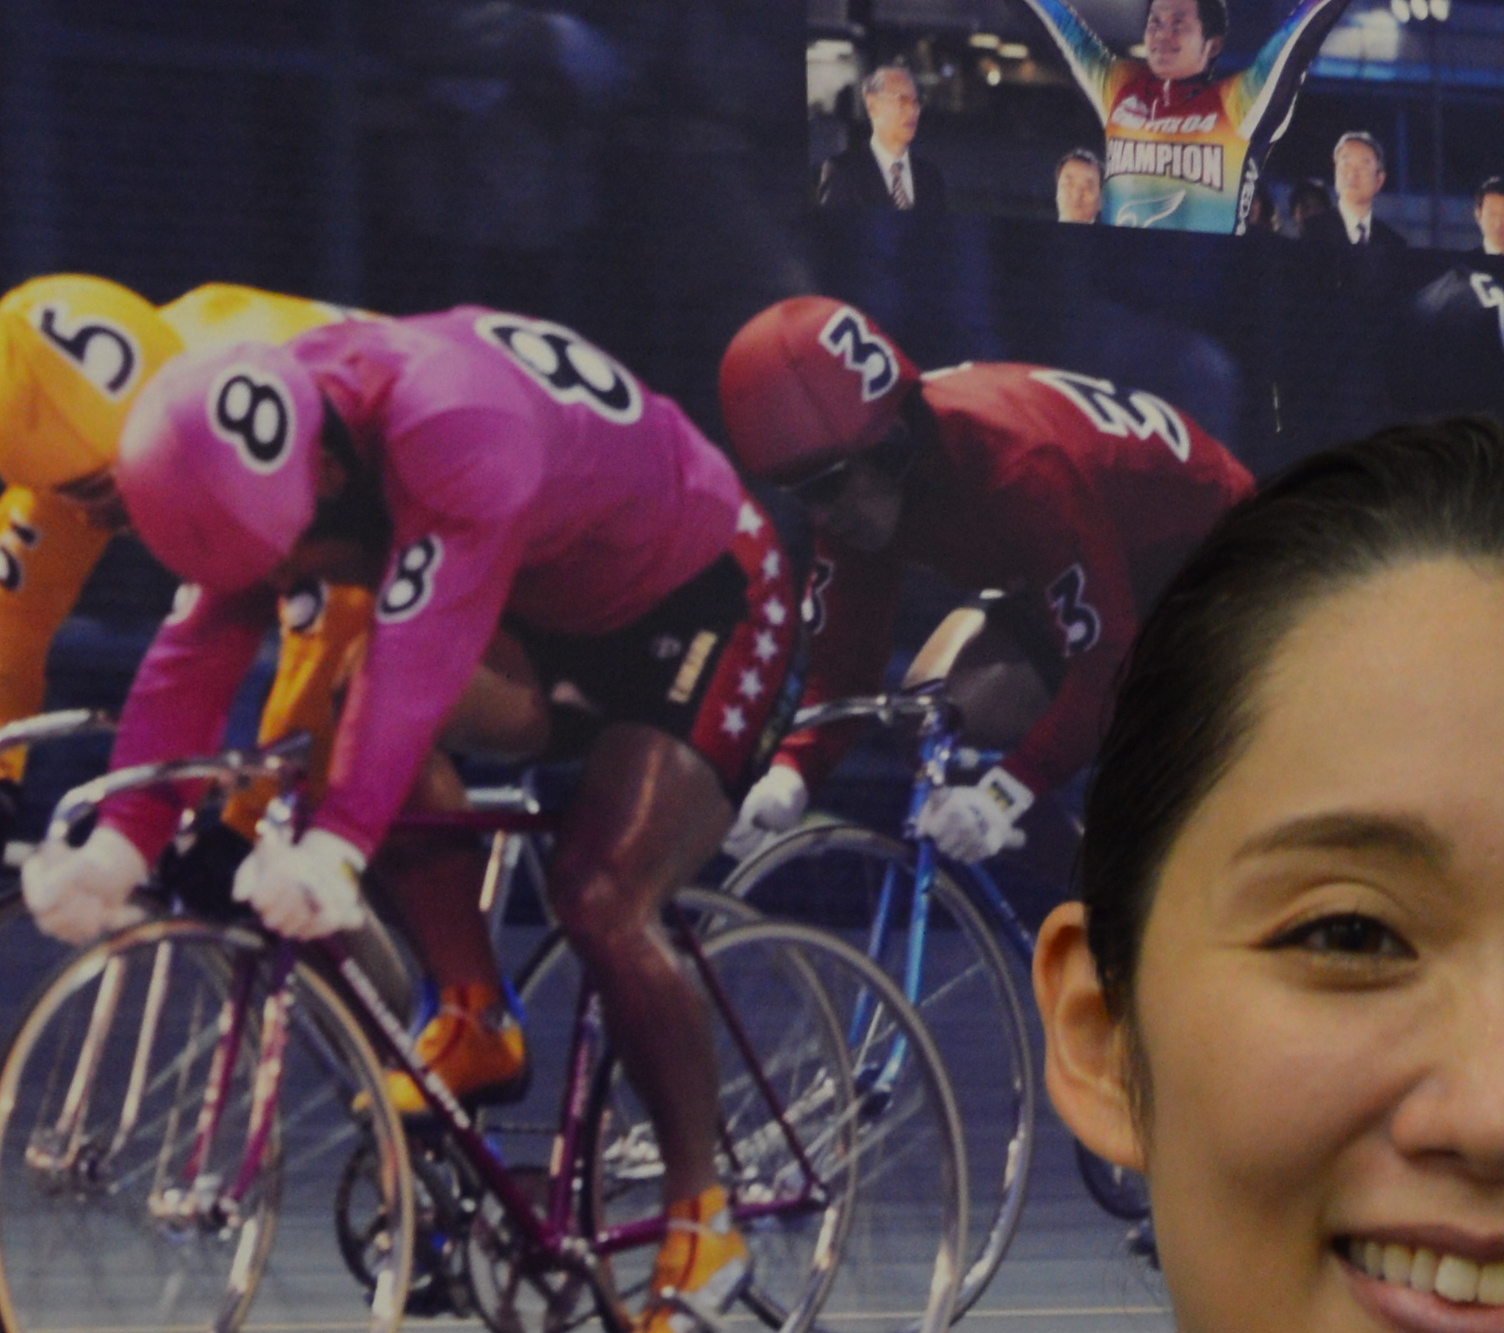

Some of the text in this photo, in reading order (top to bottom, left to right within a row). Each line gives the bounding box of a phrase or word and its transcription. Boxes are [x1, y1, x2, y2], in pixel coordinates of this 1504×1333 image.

[36, 302, 138, 395] 5
[473, 312, 644, 425] 8
[818, 305, 900, 401] 3
[207, 364, 294, 475] 8
[377, 533, 445, 624] 8
[1044, 563, 1100, 658] 3
